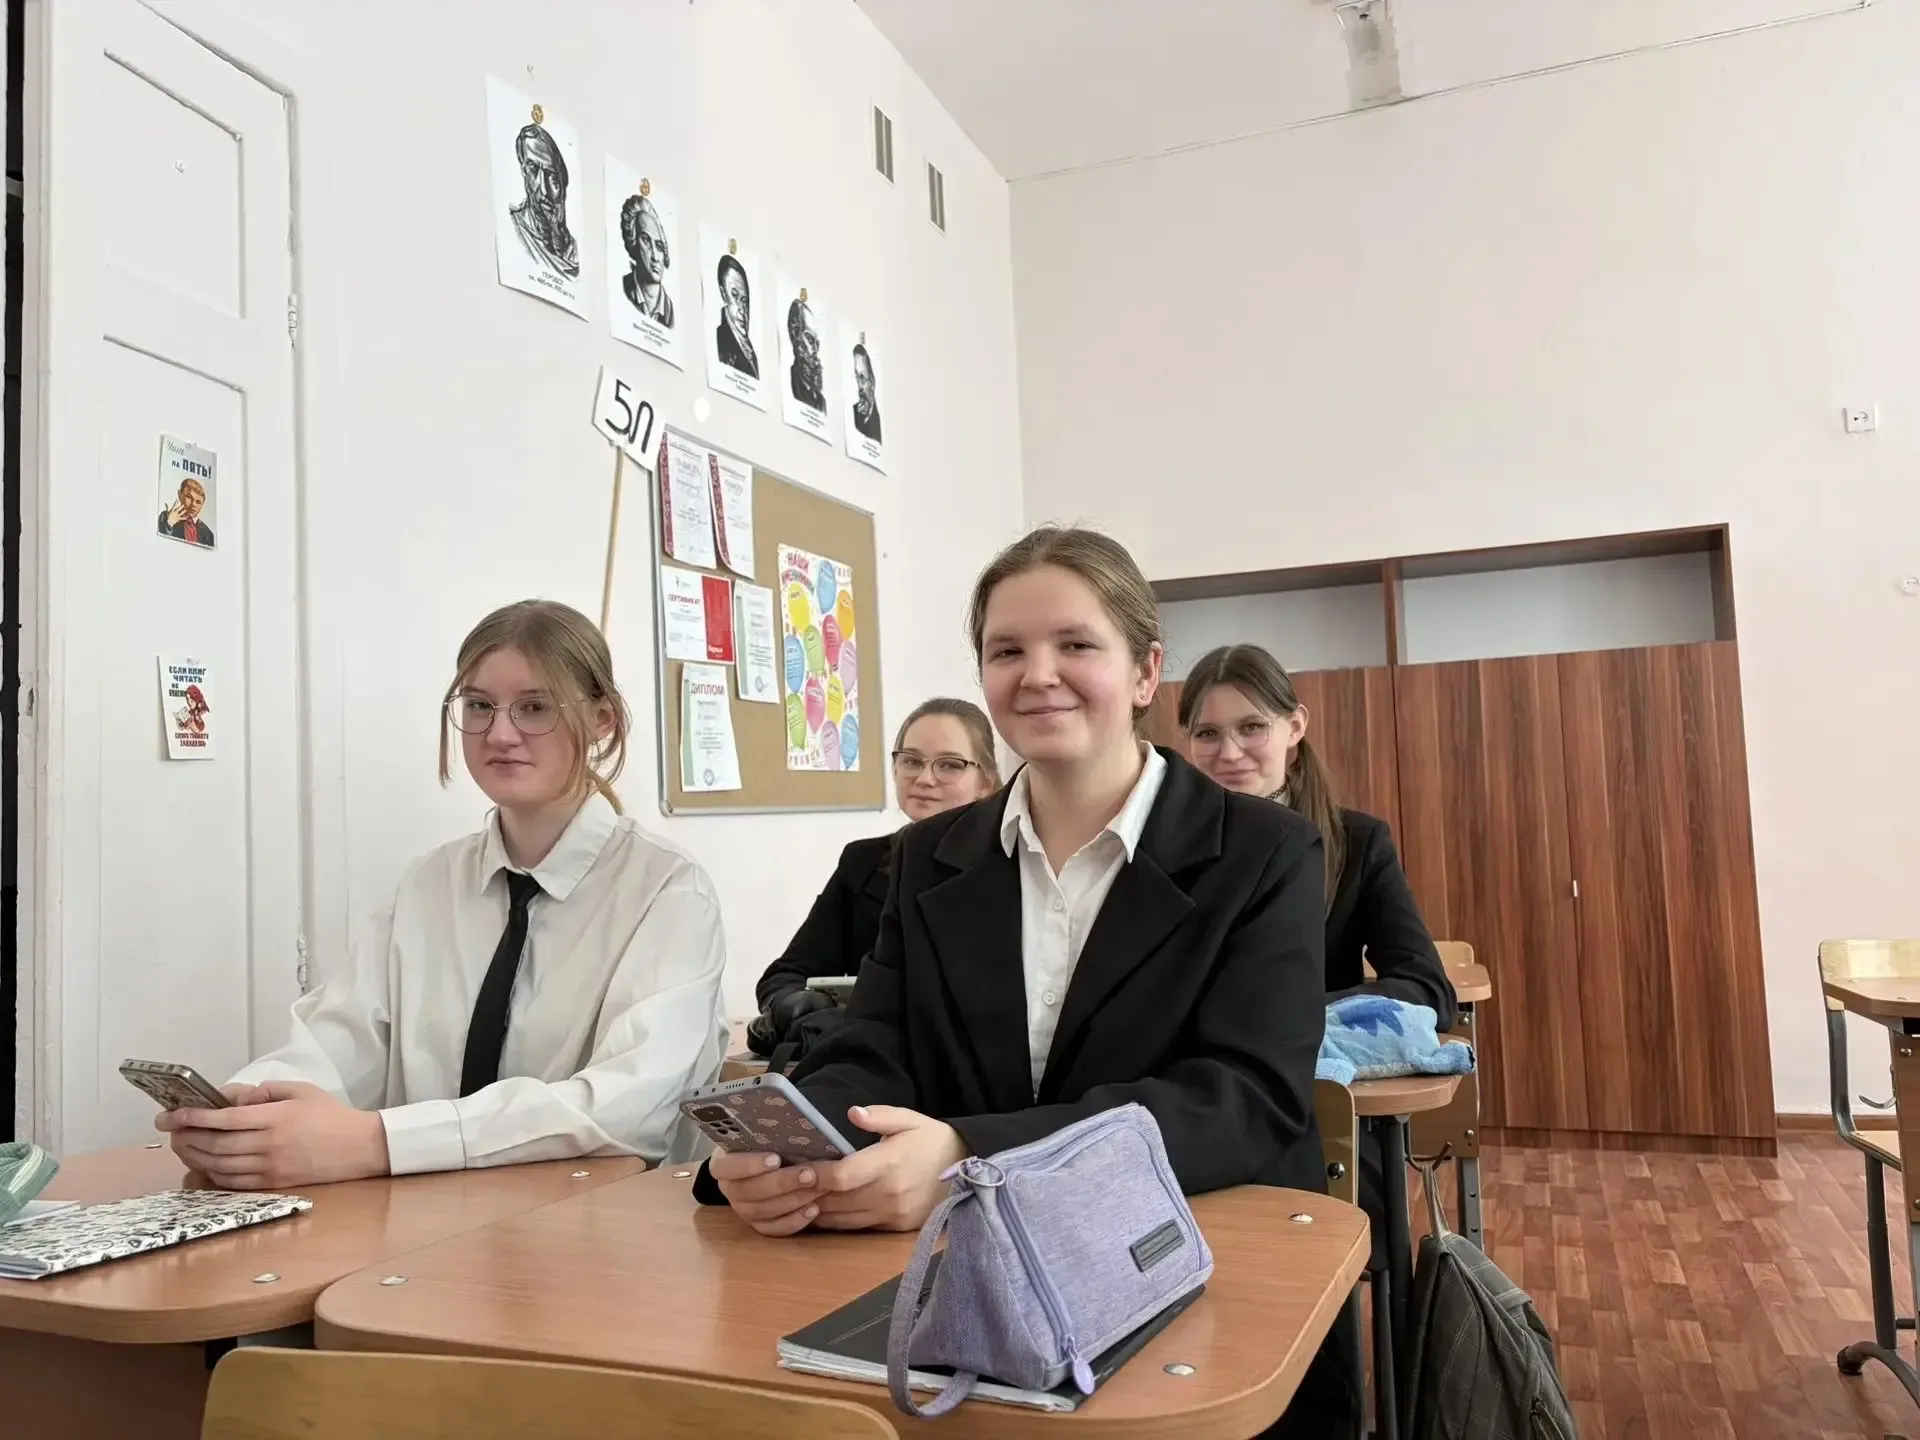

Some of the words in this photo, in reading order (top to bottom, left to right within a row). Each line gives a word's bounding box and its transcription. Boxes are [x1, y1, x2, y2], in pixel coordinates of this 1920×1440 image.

[182, 458, 212, 479] ПЯТЬ!
[168, 665, 187, 674] ЕСЛИ
[173, 675, 202, 683] ЧИТАТЬ
[690, 683, 725, 696] ДИПЛОМ
